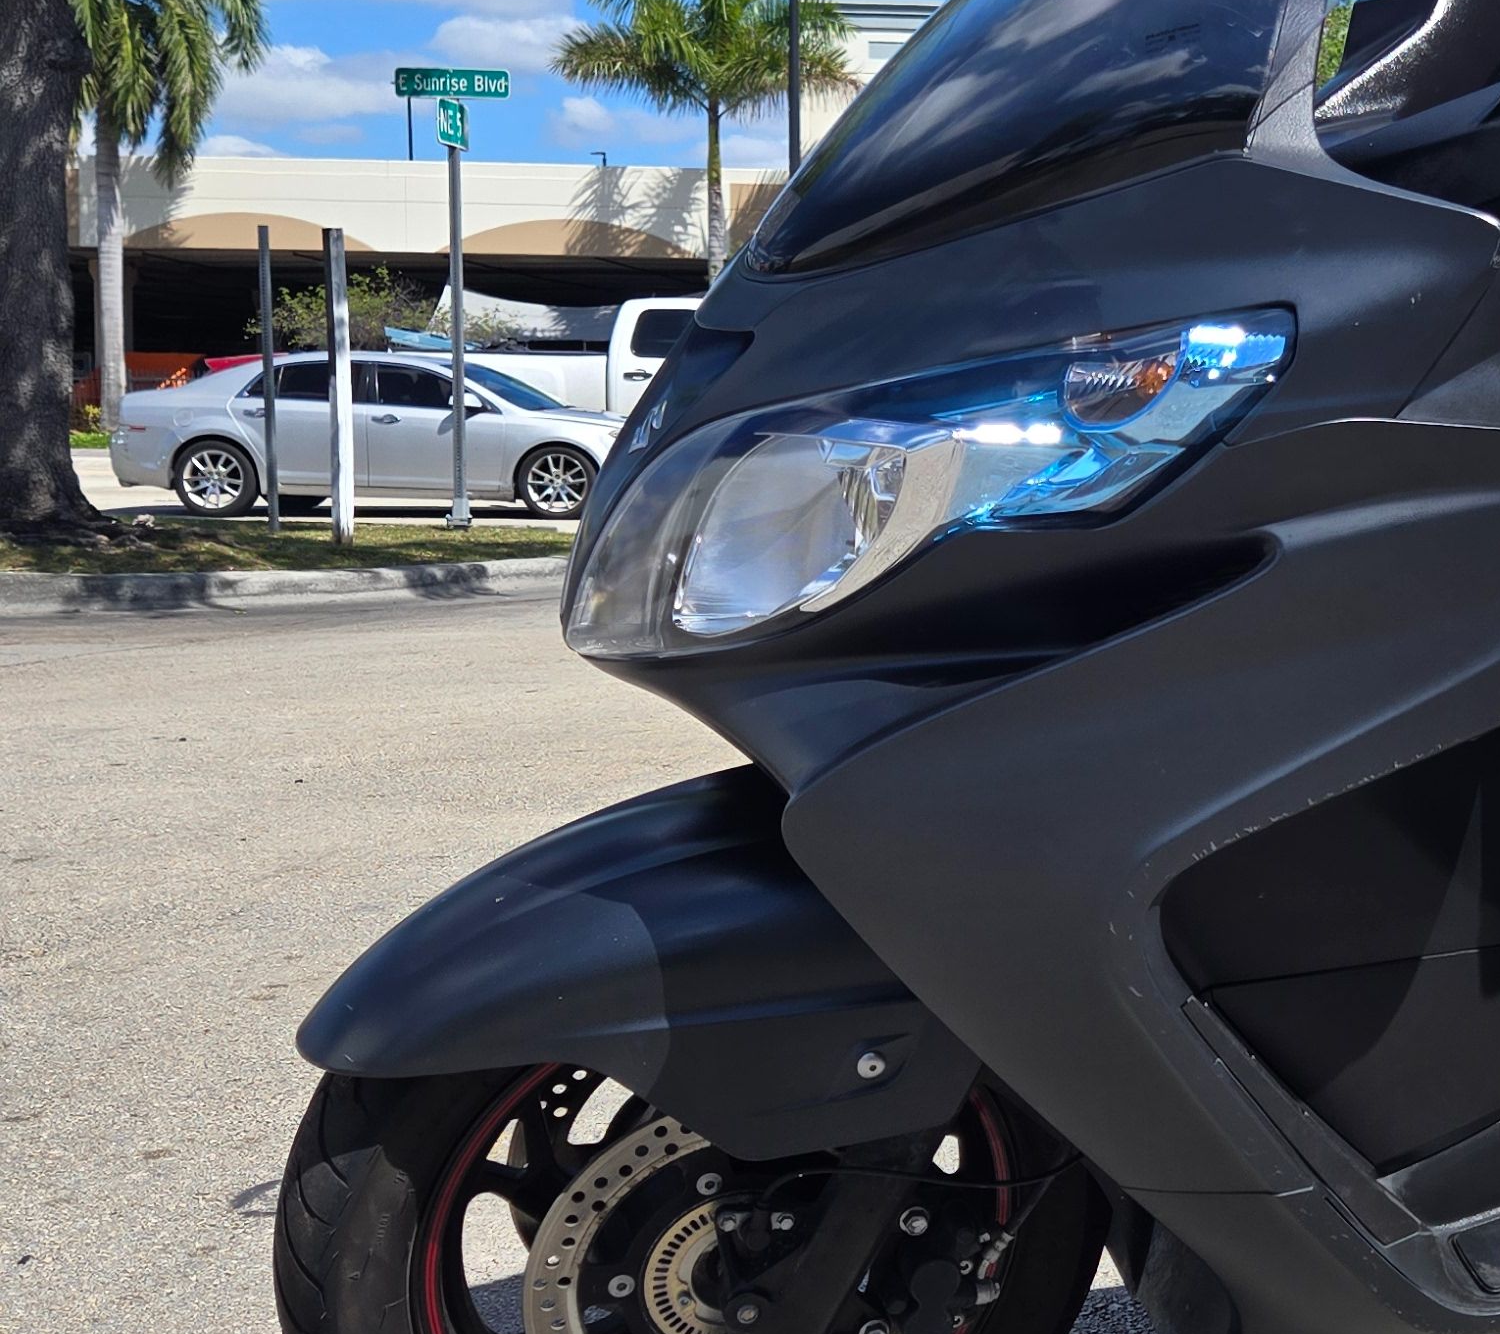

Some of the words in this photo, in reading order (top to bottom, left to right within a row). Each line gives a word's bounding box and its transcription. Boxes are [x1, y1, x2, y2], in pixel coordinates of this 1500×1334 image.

[399, 74, 408, 91] E
[414, 74, 468, 92] Sunrise
[474, 74, 505, 93] Blvd
[440, 107, 454, 135] NE
